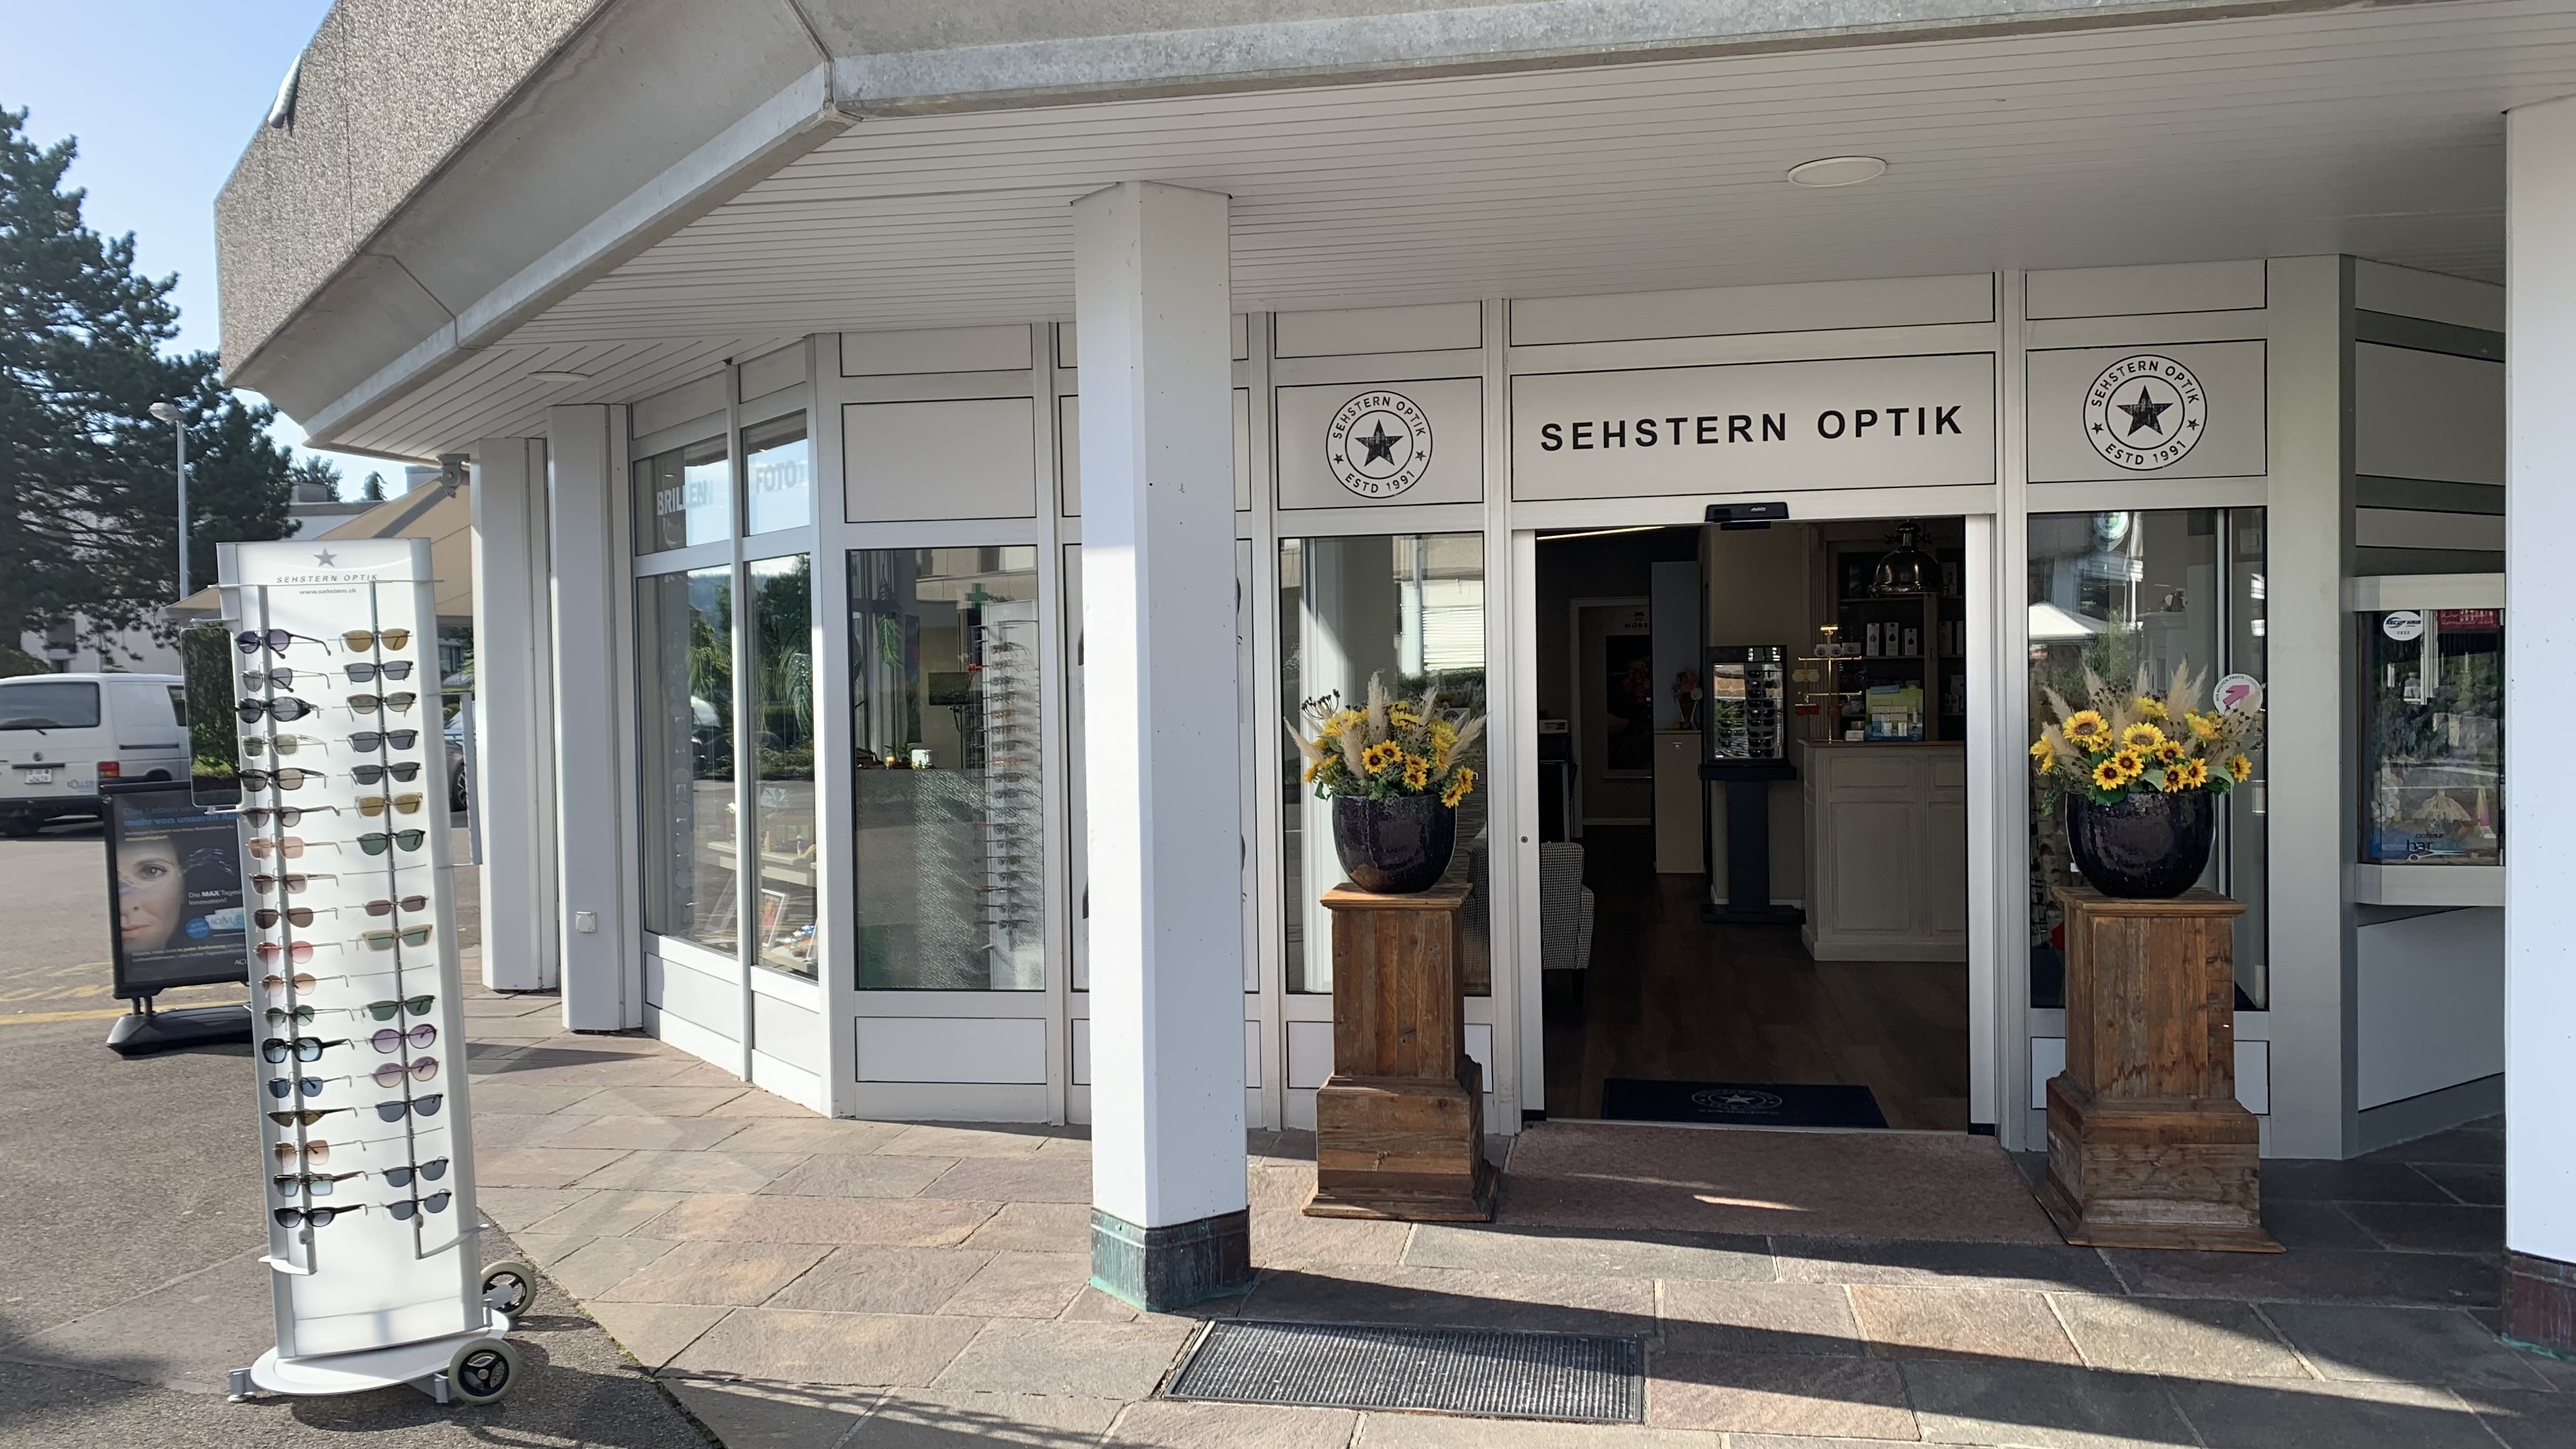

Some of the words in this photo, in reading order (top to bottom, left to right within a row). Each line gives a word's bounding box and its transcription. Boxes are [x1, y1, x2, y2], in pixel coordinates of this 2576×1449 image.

[2090, 360, 2159, 408] SEHSTERN
[2165, 365, 2200, 404] OPTIK
[1333, 395, 1391, 440] SEHSTERN
[1395, 401, 1427, 437] OPTIK
[1540, 413, 1786, 452] SEHSTERN
[1817, 405, 1963, 440] OPTIK
[2104, 443, 2144, 465] ESTD
[2152, 440, 2187, 464] 1991
[756, 459, 797, 494] FOTO
[1344, 472, 1379, 493] ESTD
[1386, 470, 1415, 492] 1991
[276, 575, 338, 583] SEHSTERN
[344, 573, 378, 581] OPTIK
[155, 816, 175, 825] von
